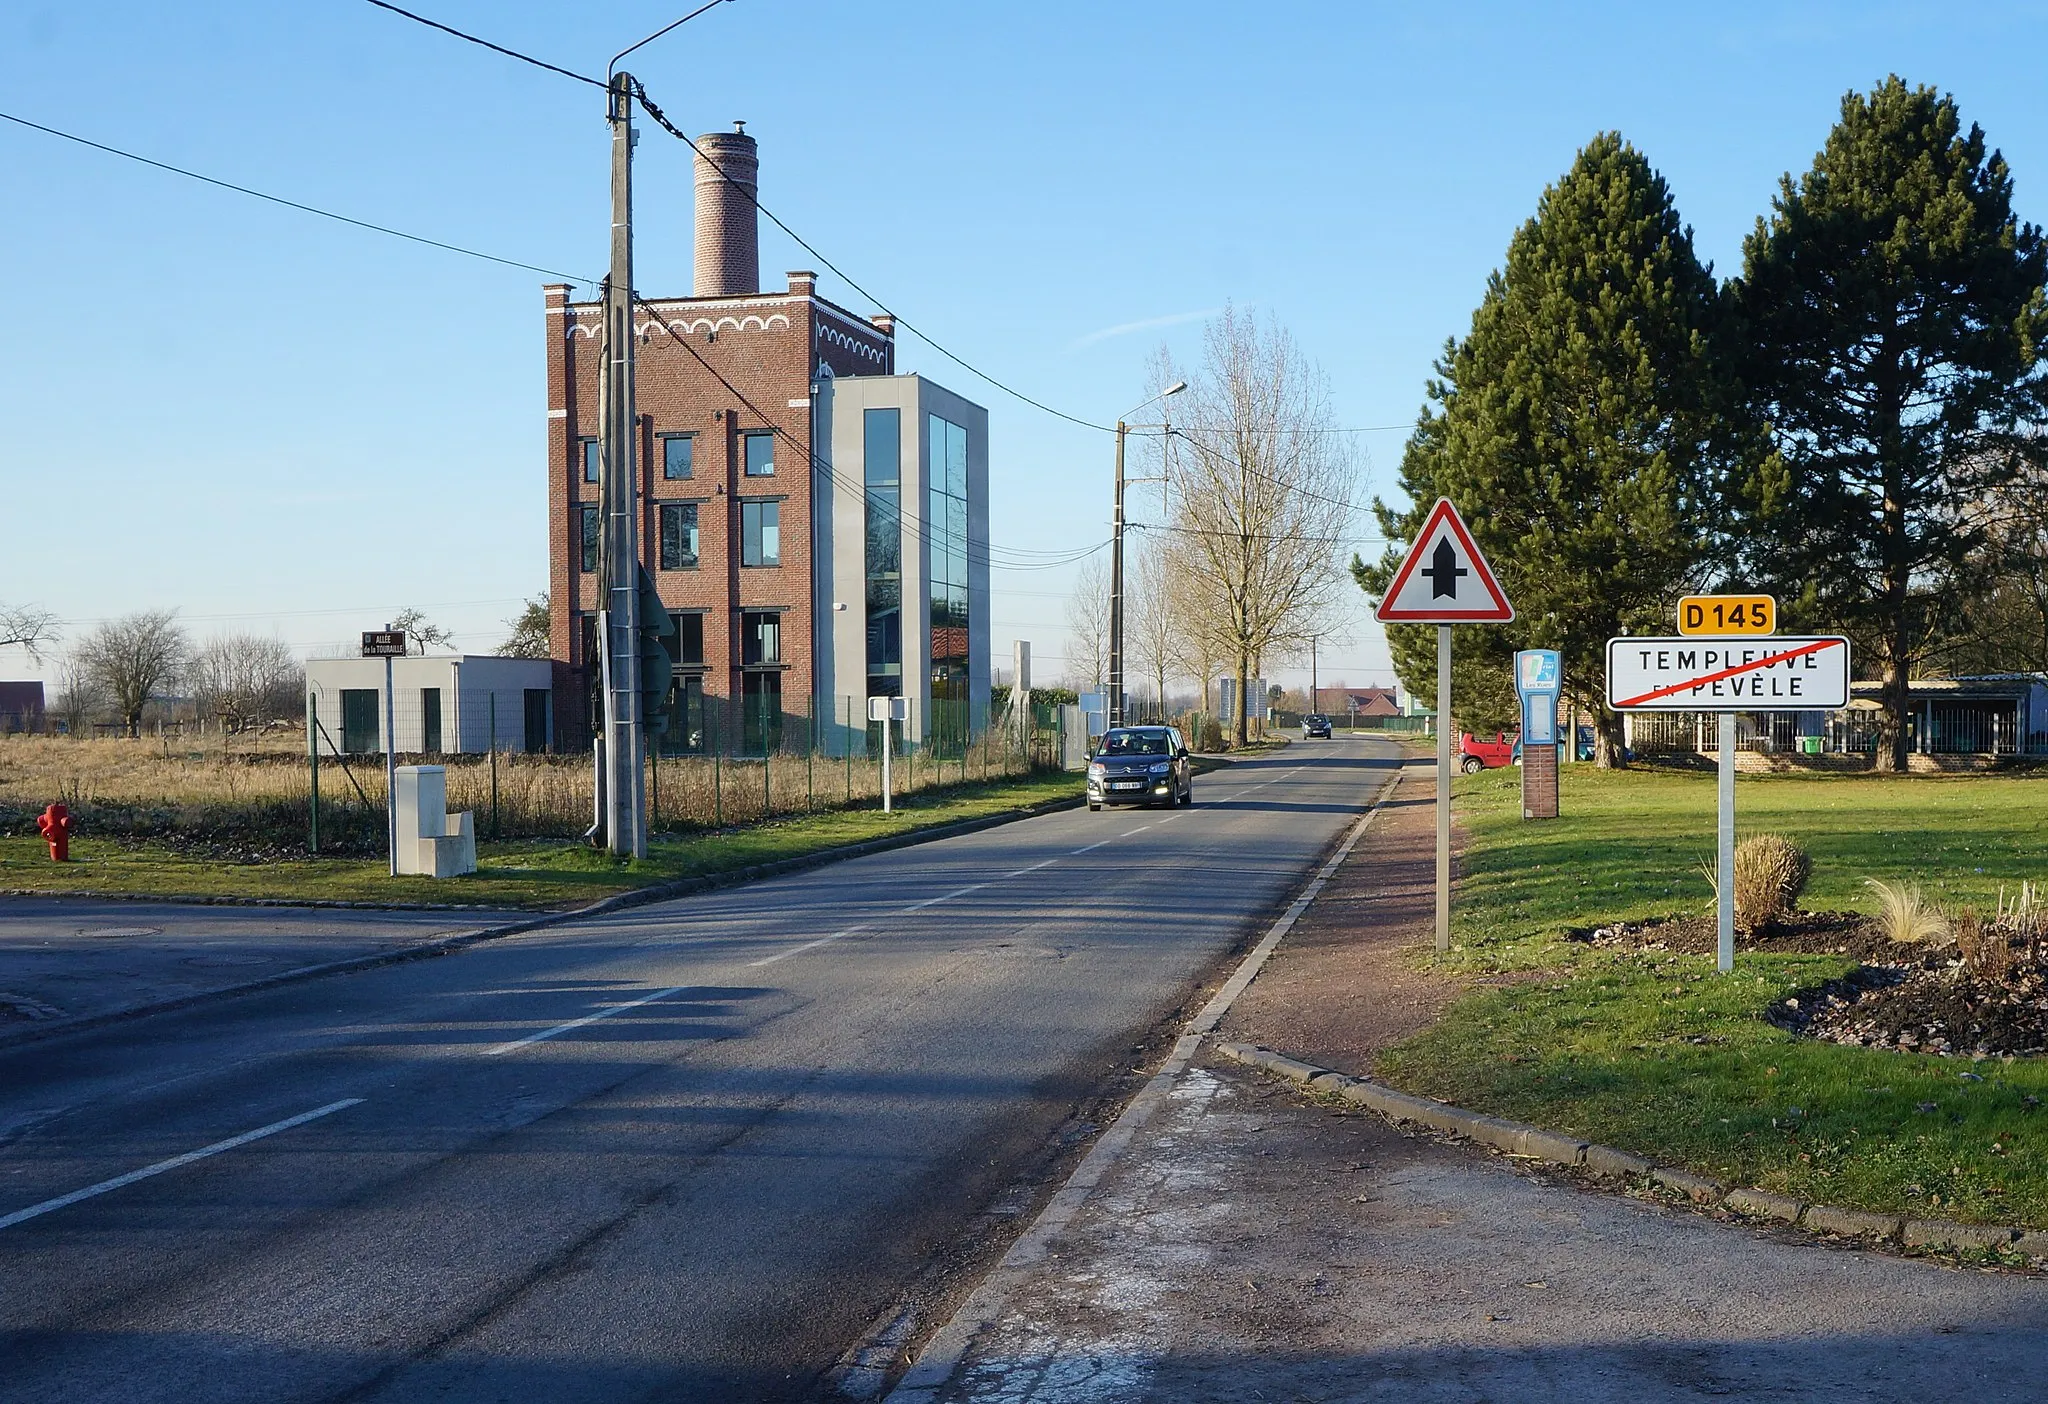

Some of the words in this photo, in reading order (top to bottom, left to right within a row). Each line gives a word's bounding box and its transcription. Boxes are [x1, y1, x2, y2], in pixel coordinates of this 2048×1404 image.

[1687, 605, 1703, 628] D
[1713, 604, 1767, 628] 145
[376, 634, 391, 644] ALLÉE
[1639, 651, 1818, 669] TEMPLEUVE
